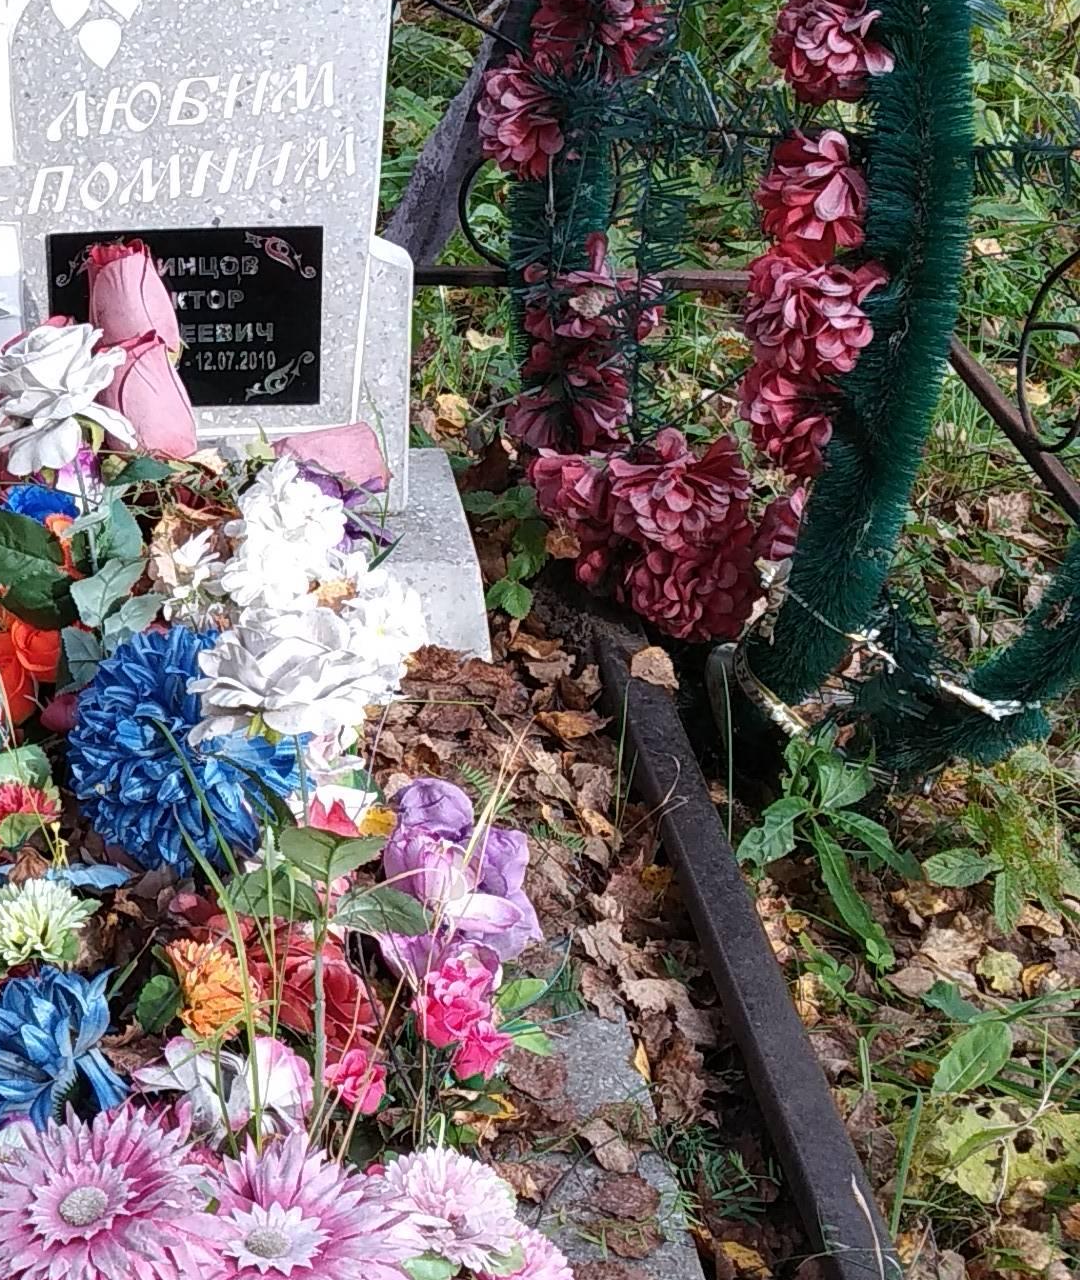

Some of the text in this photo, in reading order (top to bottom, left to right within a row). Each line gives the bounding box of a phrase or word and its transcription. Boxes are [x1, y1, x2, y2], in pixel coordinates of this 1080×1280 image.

[46, 61, 334, 142] ЛЮБИМ
[27, 133, 356, 215] ПОМНИМ
[157, 255, 260, 279] ИНЦОВ
[172, 289, 245, 310] КТОР
[180, 322, 274, 343] ЕЕВИЧ
[195, 350, 276, 371] 12.07.2010
